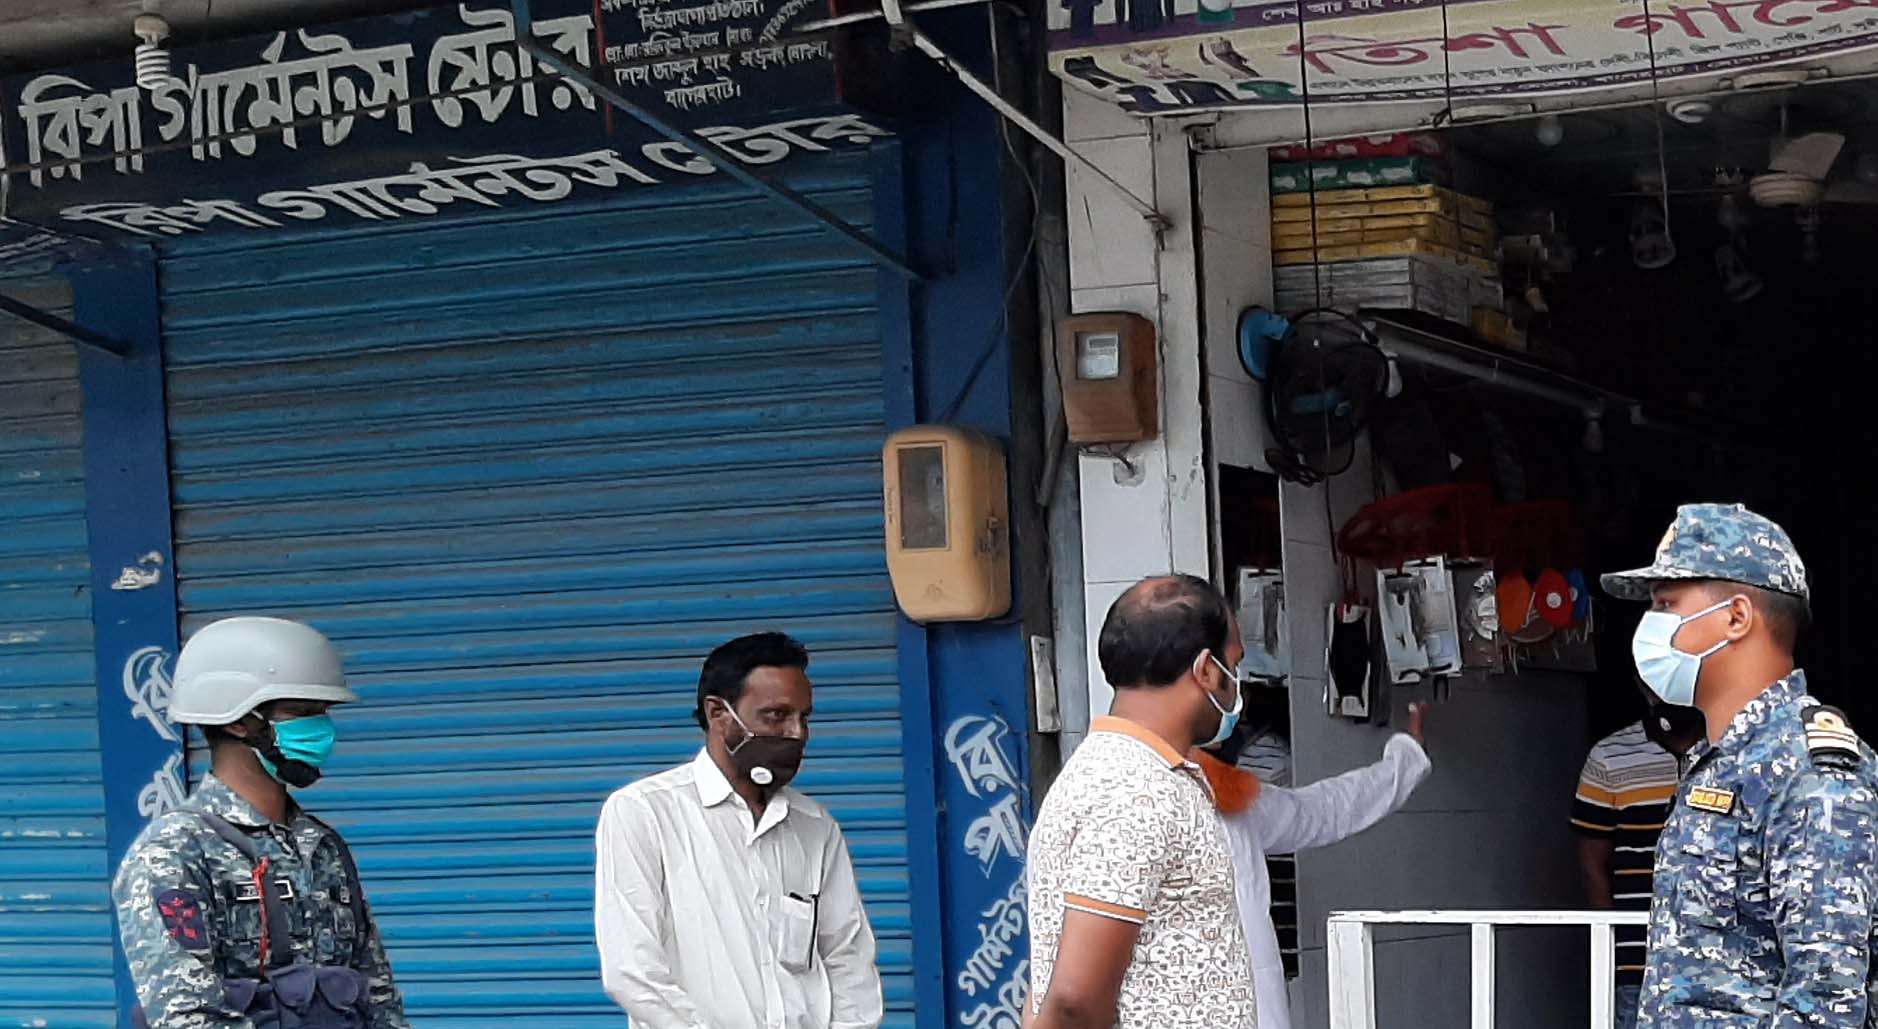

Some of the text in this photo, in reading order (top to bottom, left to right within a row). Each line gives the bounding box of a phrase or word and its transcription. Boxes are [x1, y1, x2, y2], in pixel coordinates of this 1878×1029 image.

[18, 74, 145, 188] রিপা
[151, 28, 415, 161] গার্মেন্টস
[59, 198, 284, 238] রিপা
[257, 149, 658, 222] গার্মেন্টস
